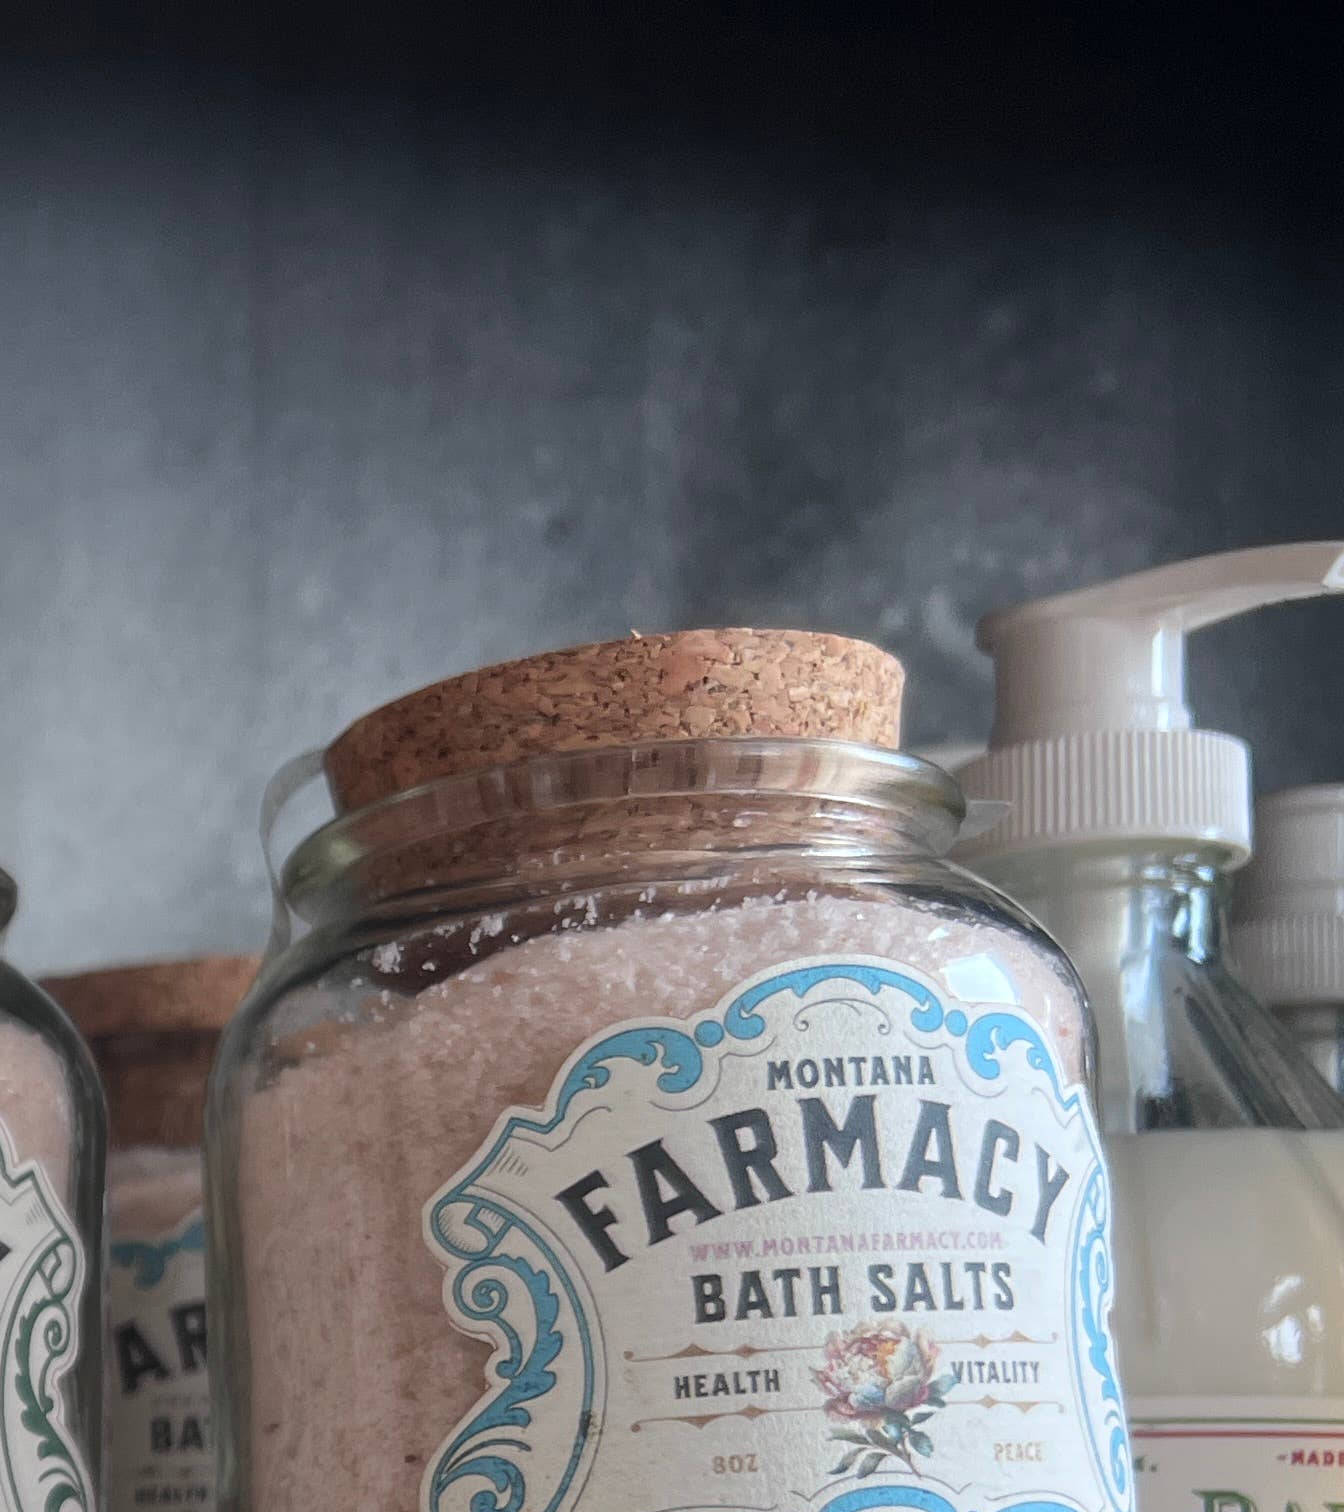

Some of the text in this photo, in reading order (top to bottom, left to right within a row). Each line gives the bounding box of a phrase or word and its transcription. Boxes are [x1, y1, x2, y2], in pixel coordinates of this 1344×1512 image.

[767, 1055, 935, 1091] MONTANA
[554, 1095, 1070, 1273] FARMACY
[691, 1262, 1014, 1324] BATH SALTS
[673, 1360, 1040, 1400] HEALTH VITALITY
[994, 1442, 1044, 1463] PEACE
